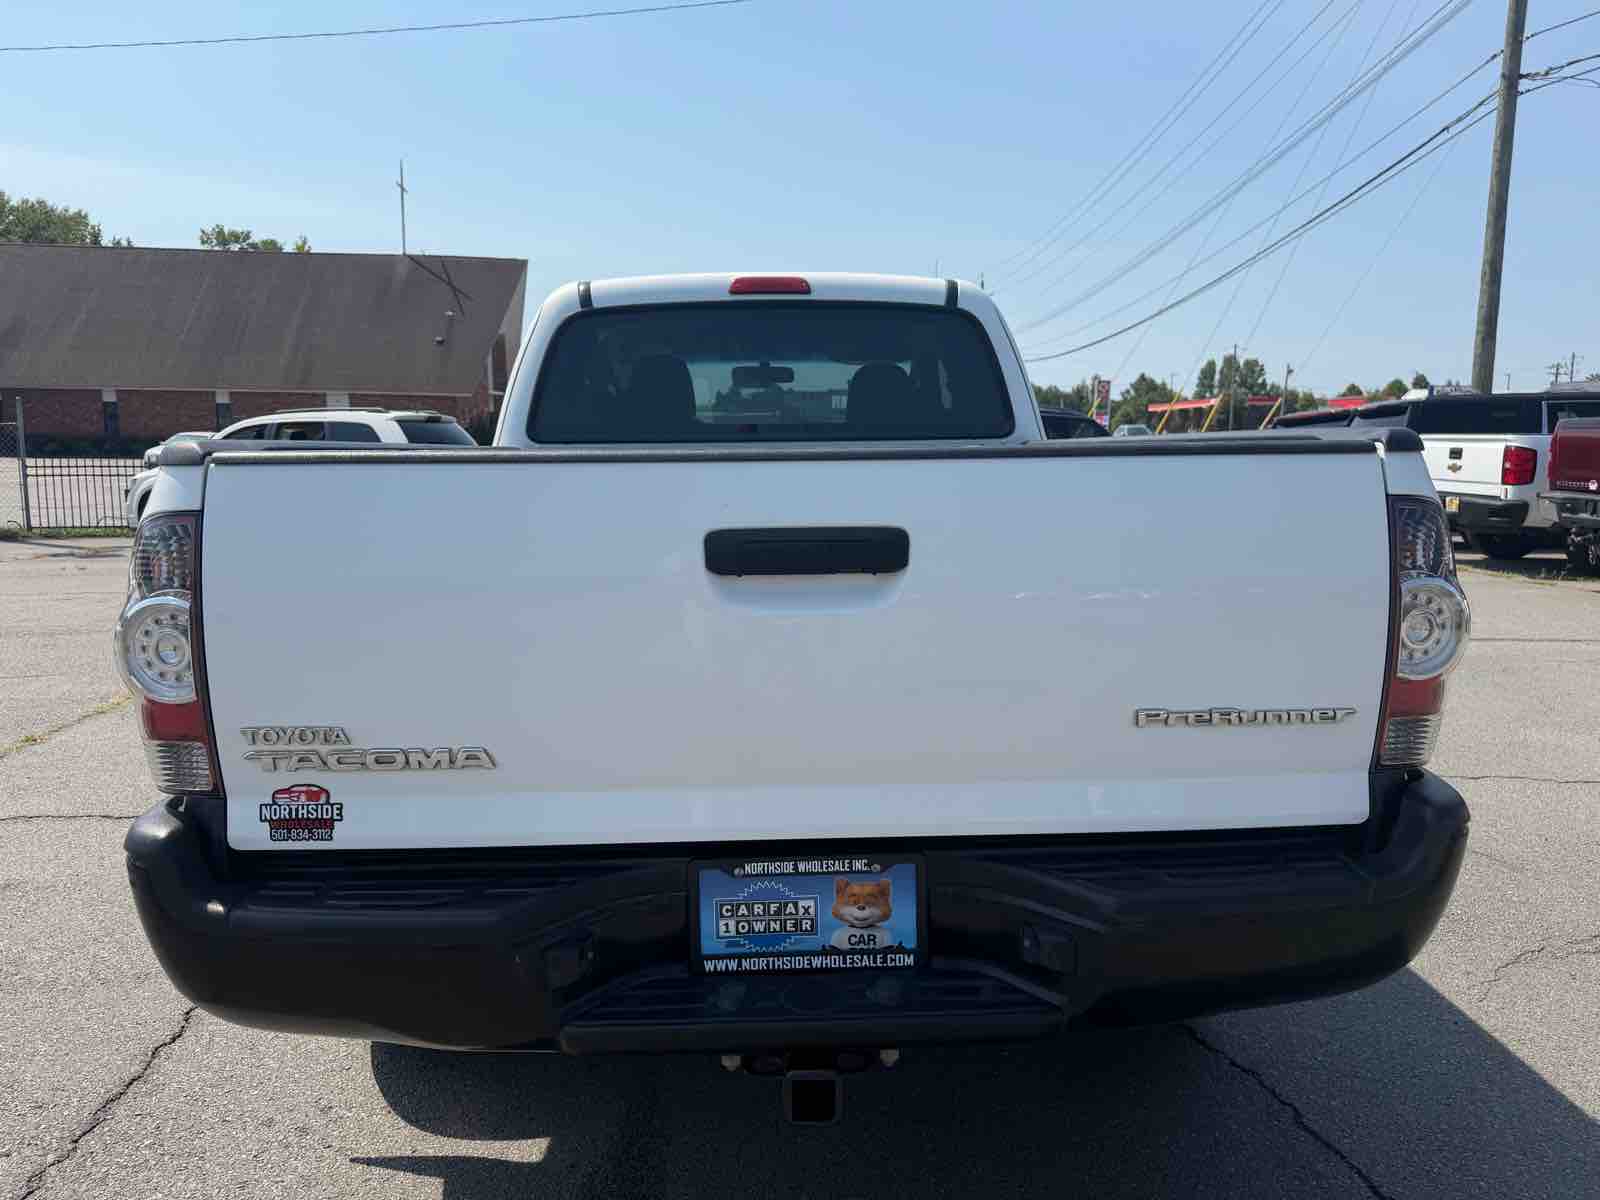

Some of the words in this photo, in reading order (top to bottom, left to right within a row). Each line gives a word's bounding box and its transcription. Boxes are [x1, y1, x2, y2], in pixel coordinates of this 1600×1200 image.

[1136, 708, 1356, 727] PreRunner
[240, 727, 351, 745] TOYOTA
[242, 747, 496, 772] TACOMA
[261, 804, 341, 820] NORTHSIDE
[271, 820, 334, 829] WHOLESALE
[271, 828, 332, 840] 501-834-3112
[744, 862, 795, 875] NORTHSIDE
[797, 860, 849, 873] WHOLESALE
[722, 902, 813, 917] CARFAX
[848, 934, 877, 946] CAR
[704, 953, 914, 973] WWW.NORTHSIDEWHOLESALE.COM
